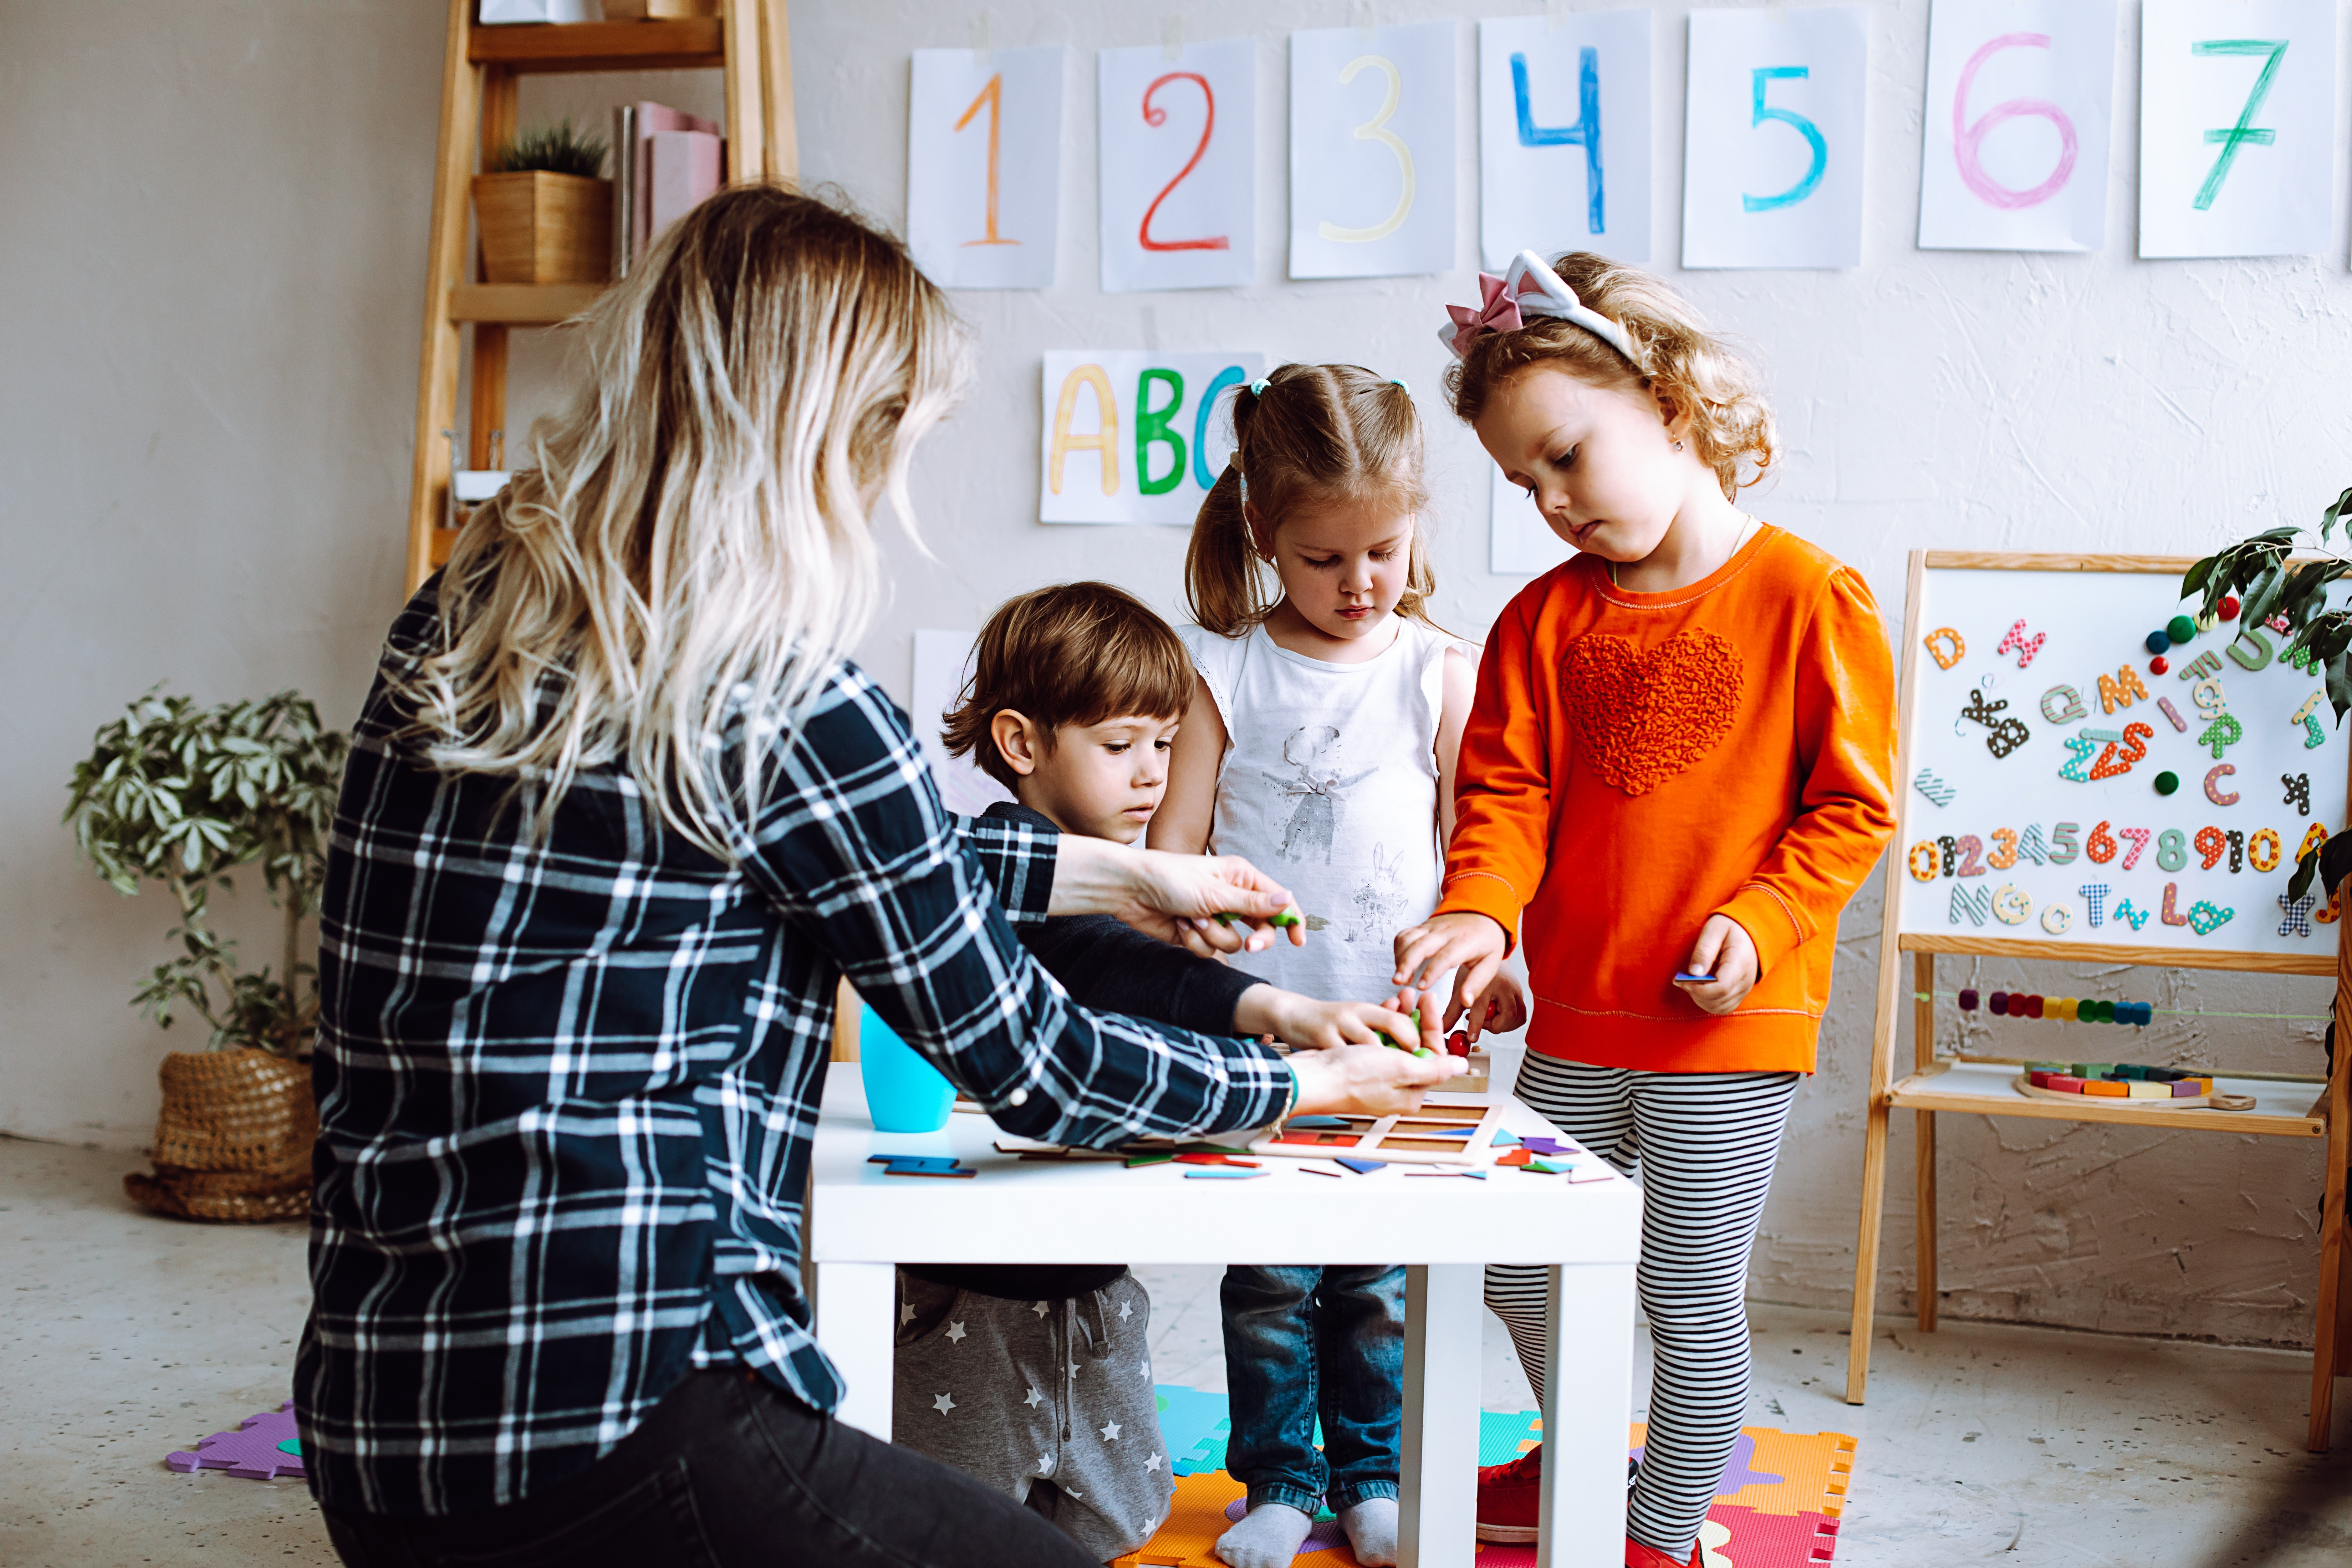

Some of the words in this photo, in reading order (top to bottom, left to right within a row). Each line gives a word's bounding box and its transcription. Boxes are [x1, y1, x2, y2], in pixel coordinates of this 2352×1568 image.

[953, 72, 1021, 247] 1
[1142, 71, 1230, 251] 2
[1317, 55, 1416, 242] 3
[1510, 46, 1606, 234] 4
[1742, 66, 1828, 214] 5
[1953, 32, 2078, 211] 6
[2192, 39, 2289, 211] 7
[1050, 363, 1245, 496] ABC
[1924, 626, 1966, 670] D
[2041, 684, 2088, 724] Q
[1986, 718, 2030, 759] B
[2119, 721, 2154, 762] S
[2205, 763, 2240, 806] C
[1950, 882, 1990, 927] N
[2079, 884, 2112, 928] T
[2162, 882, 2188, 926] L
[2278, 892, 2315, 937] X
